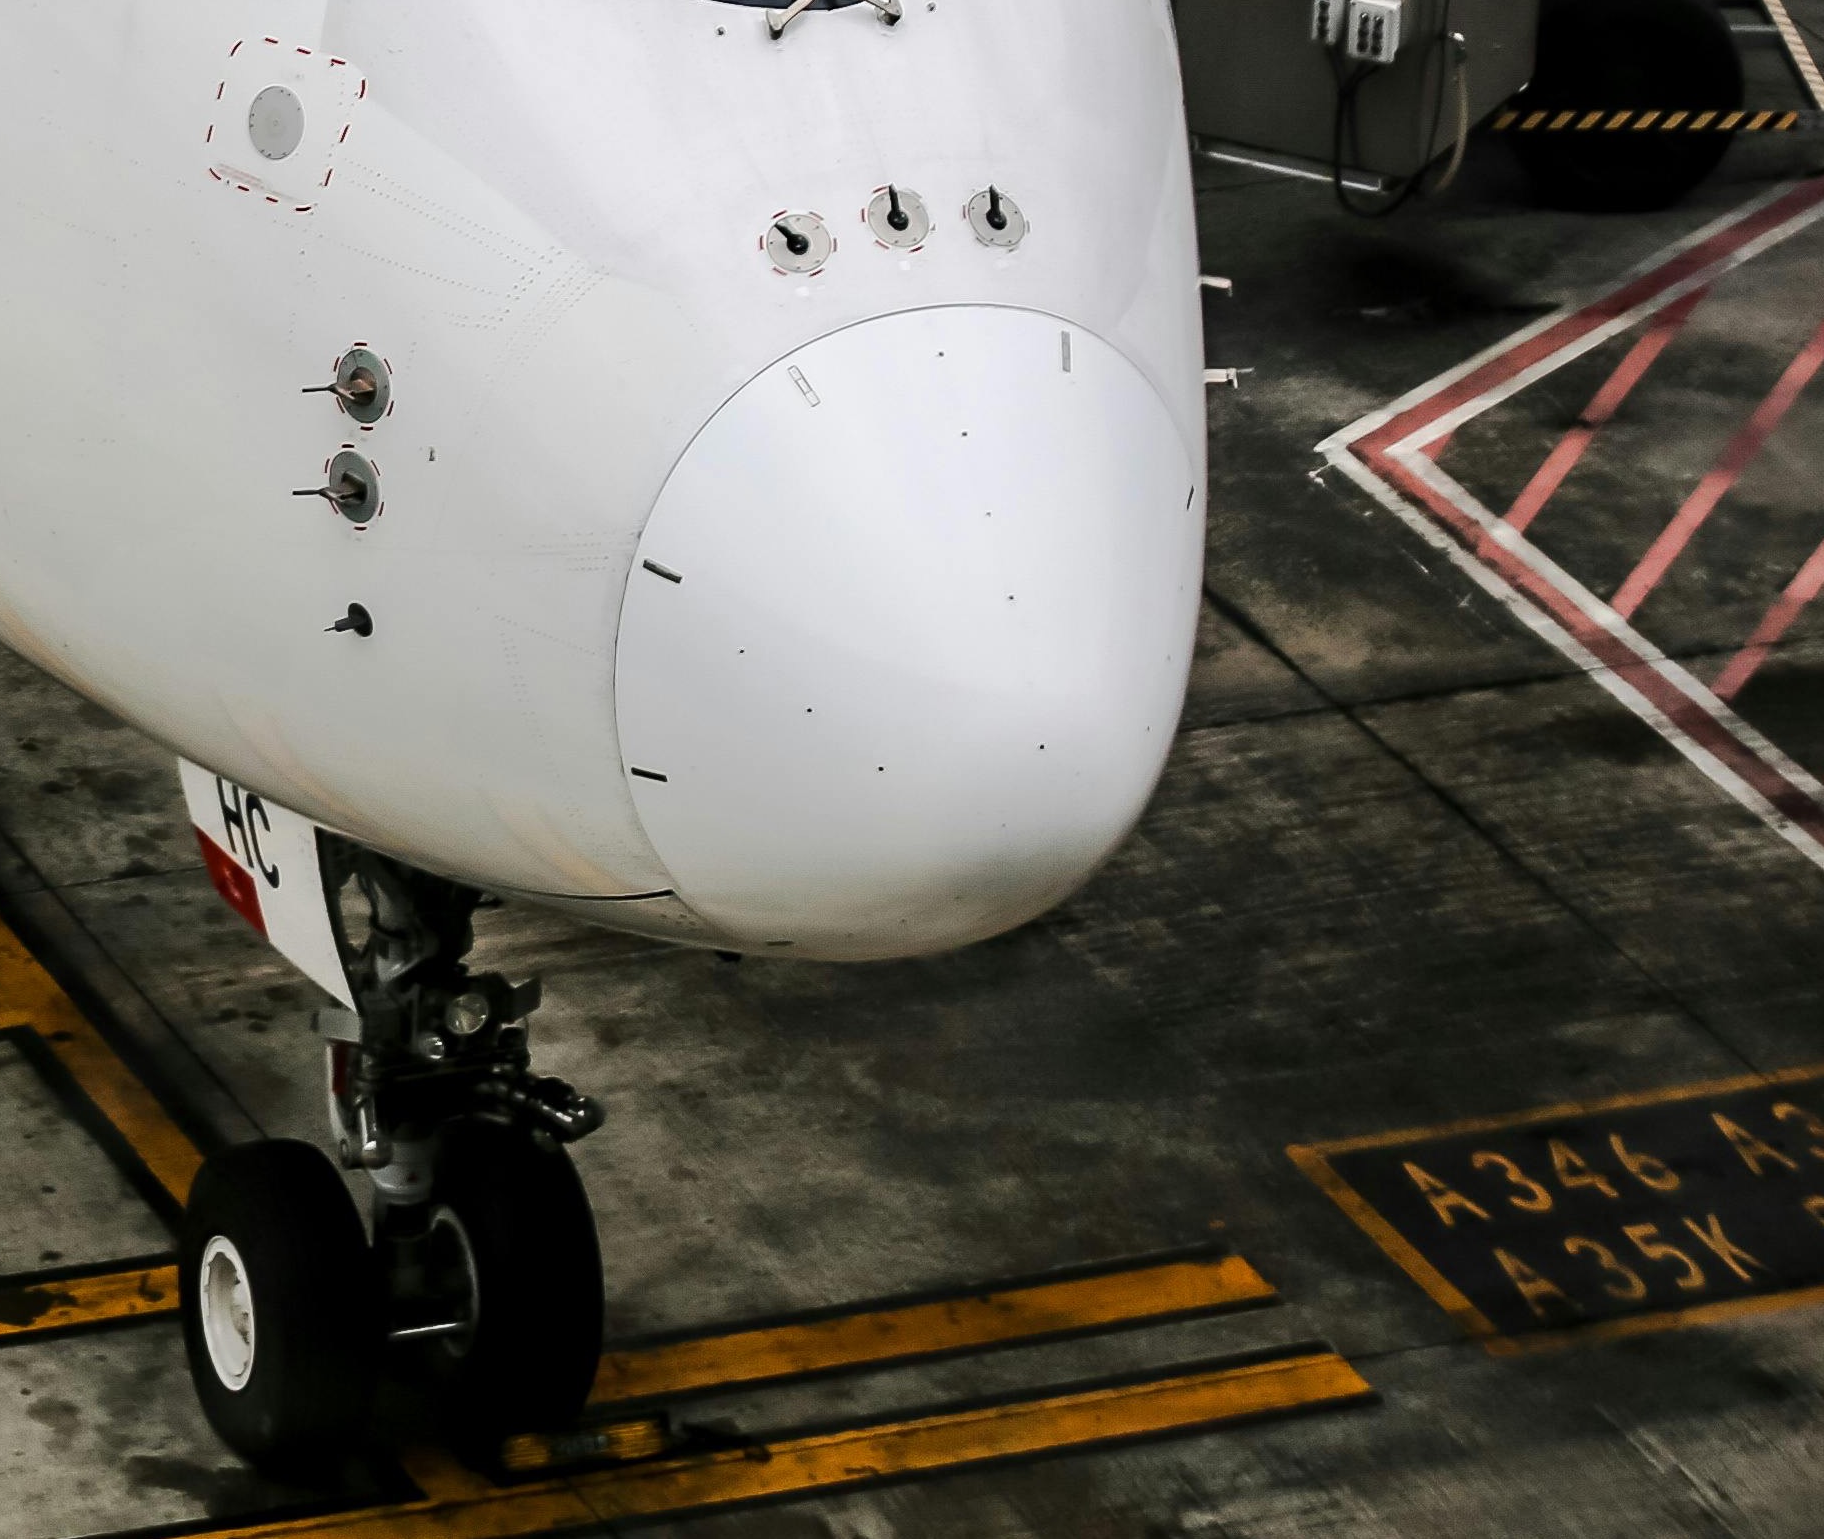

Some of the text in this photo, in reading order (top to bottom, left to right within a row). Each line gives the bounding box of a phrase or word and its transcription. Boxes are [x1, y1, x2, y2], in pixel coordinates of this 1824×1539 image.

[215, 774, 281, 889] HC
[1403, 1132, 1681, 1226] A346
[1494, 1213, 1773, 1318] A35K
